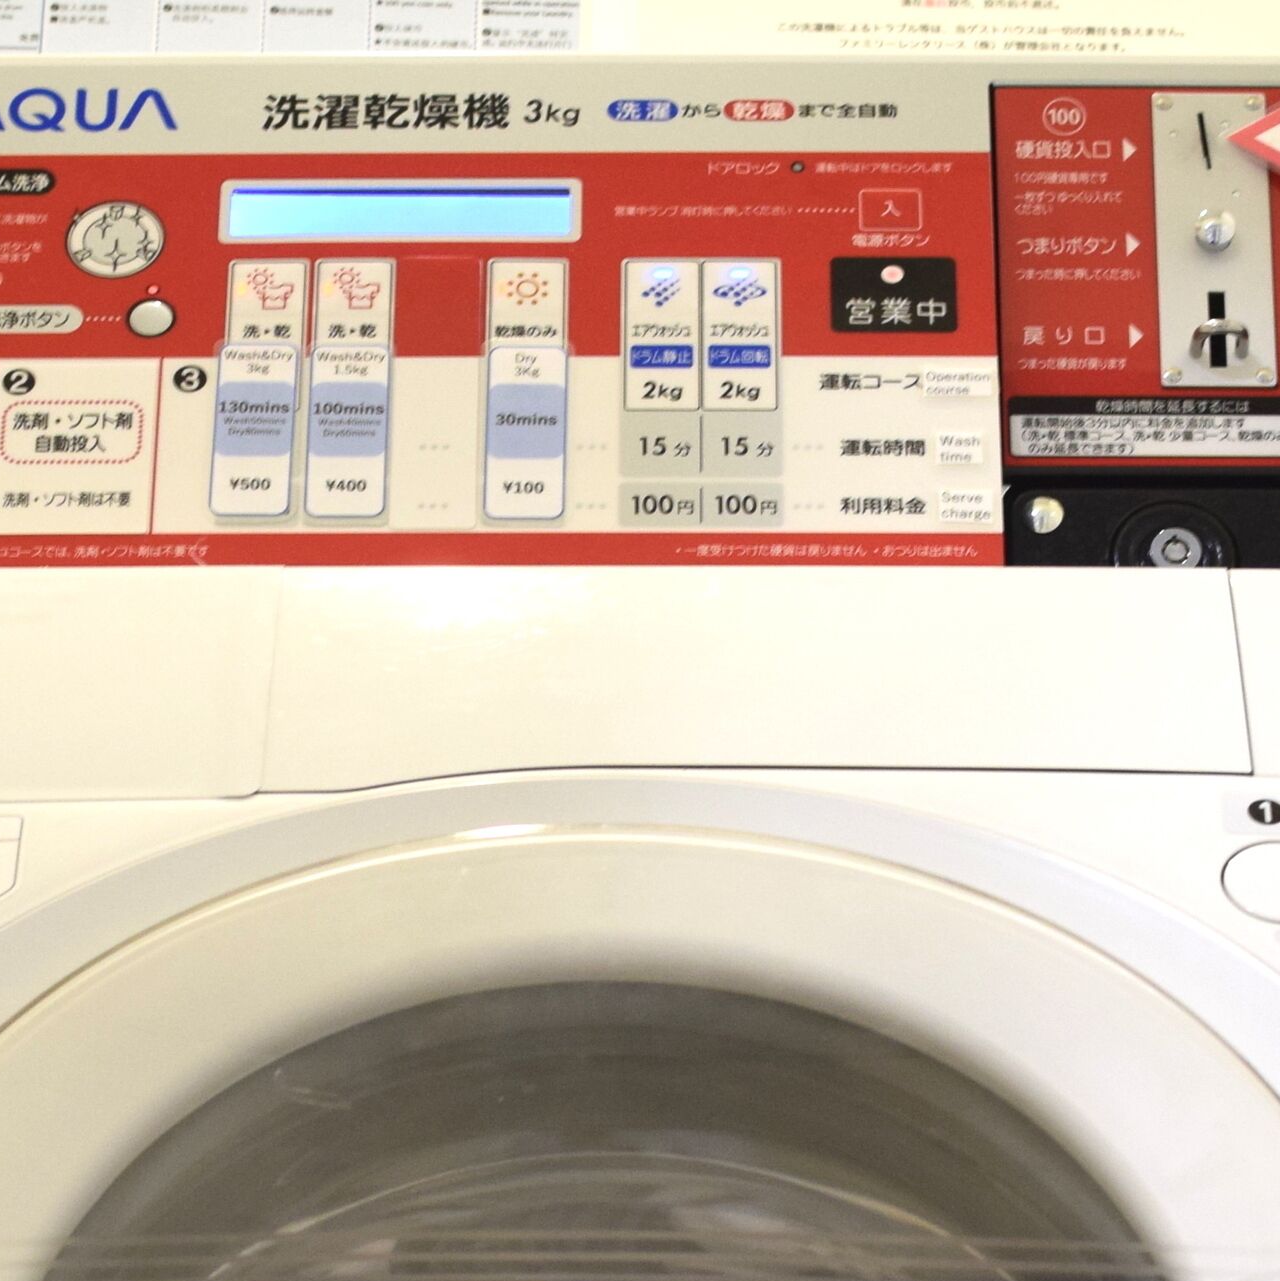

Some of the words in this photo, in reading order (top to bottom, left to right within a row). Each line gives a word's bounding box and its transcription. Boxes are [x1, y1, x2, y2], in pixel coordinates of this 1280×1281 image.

[262, 93, 511, 131] 洗濯乾燥機
[524, 100, 580, 126] 3kg
[706, 162, 781, 176] ドアロック
[851, 233, 930, 248] 電源ボタン
[1016, 236, 1118, 256] つまりボタン
[844, 297, 949, 326] 営業中
[514, 352, 537, 366] Dry
[819, 373, 921, 391] 運転コース
[924, 371, 992, 386] Operation
[641, 381, 683, 401] 2kg
[719, 381, 761, 401] 2kg
[218, 401, 290, 415] 130mins
[313, 401, 385, 416] 100mins
[494, 413, 558, 427] 30mins
[35, 434, 106, 453] 自動投入
[839, 439, 926, 457] 運転時間
[938, 434, 981, 448] Wash
[939, 451, 973, 464] time
[839, 497, 926, 515] 利用料金
[940, 507, 992, 522] charge
